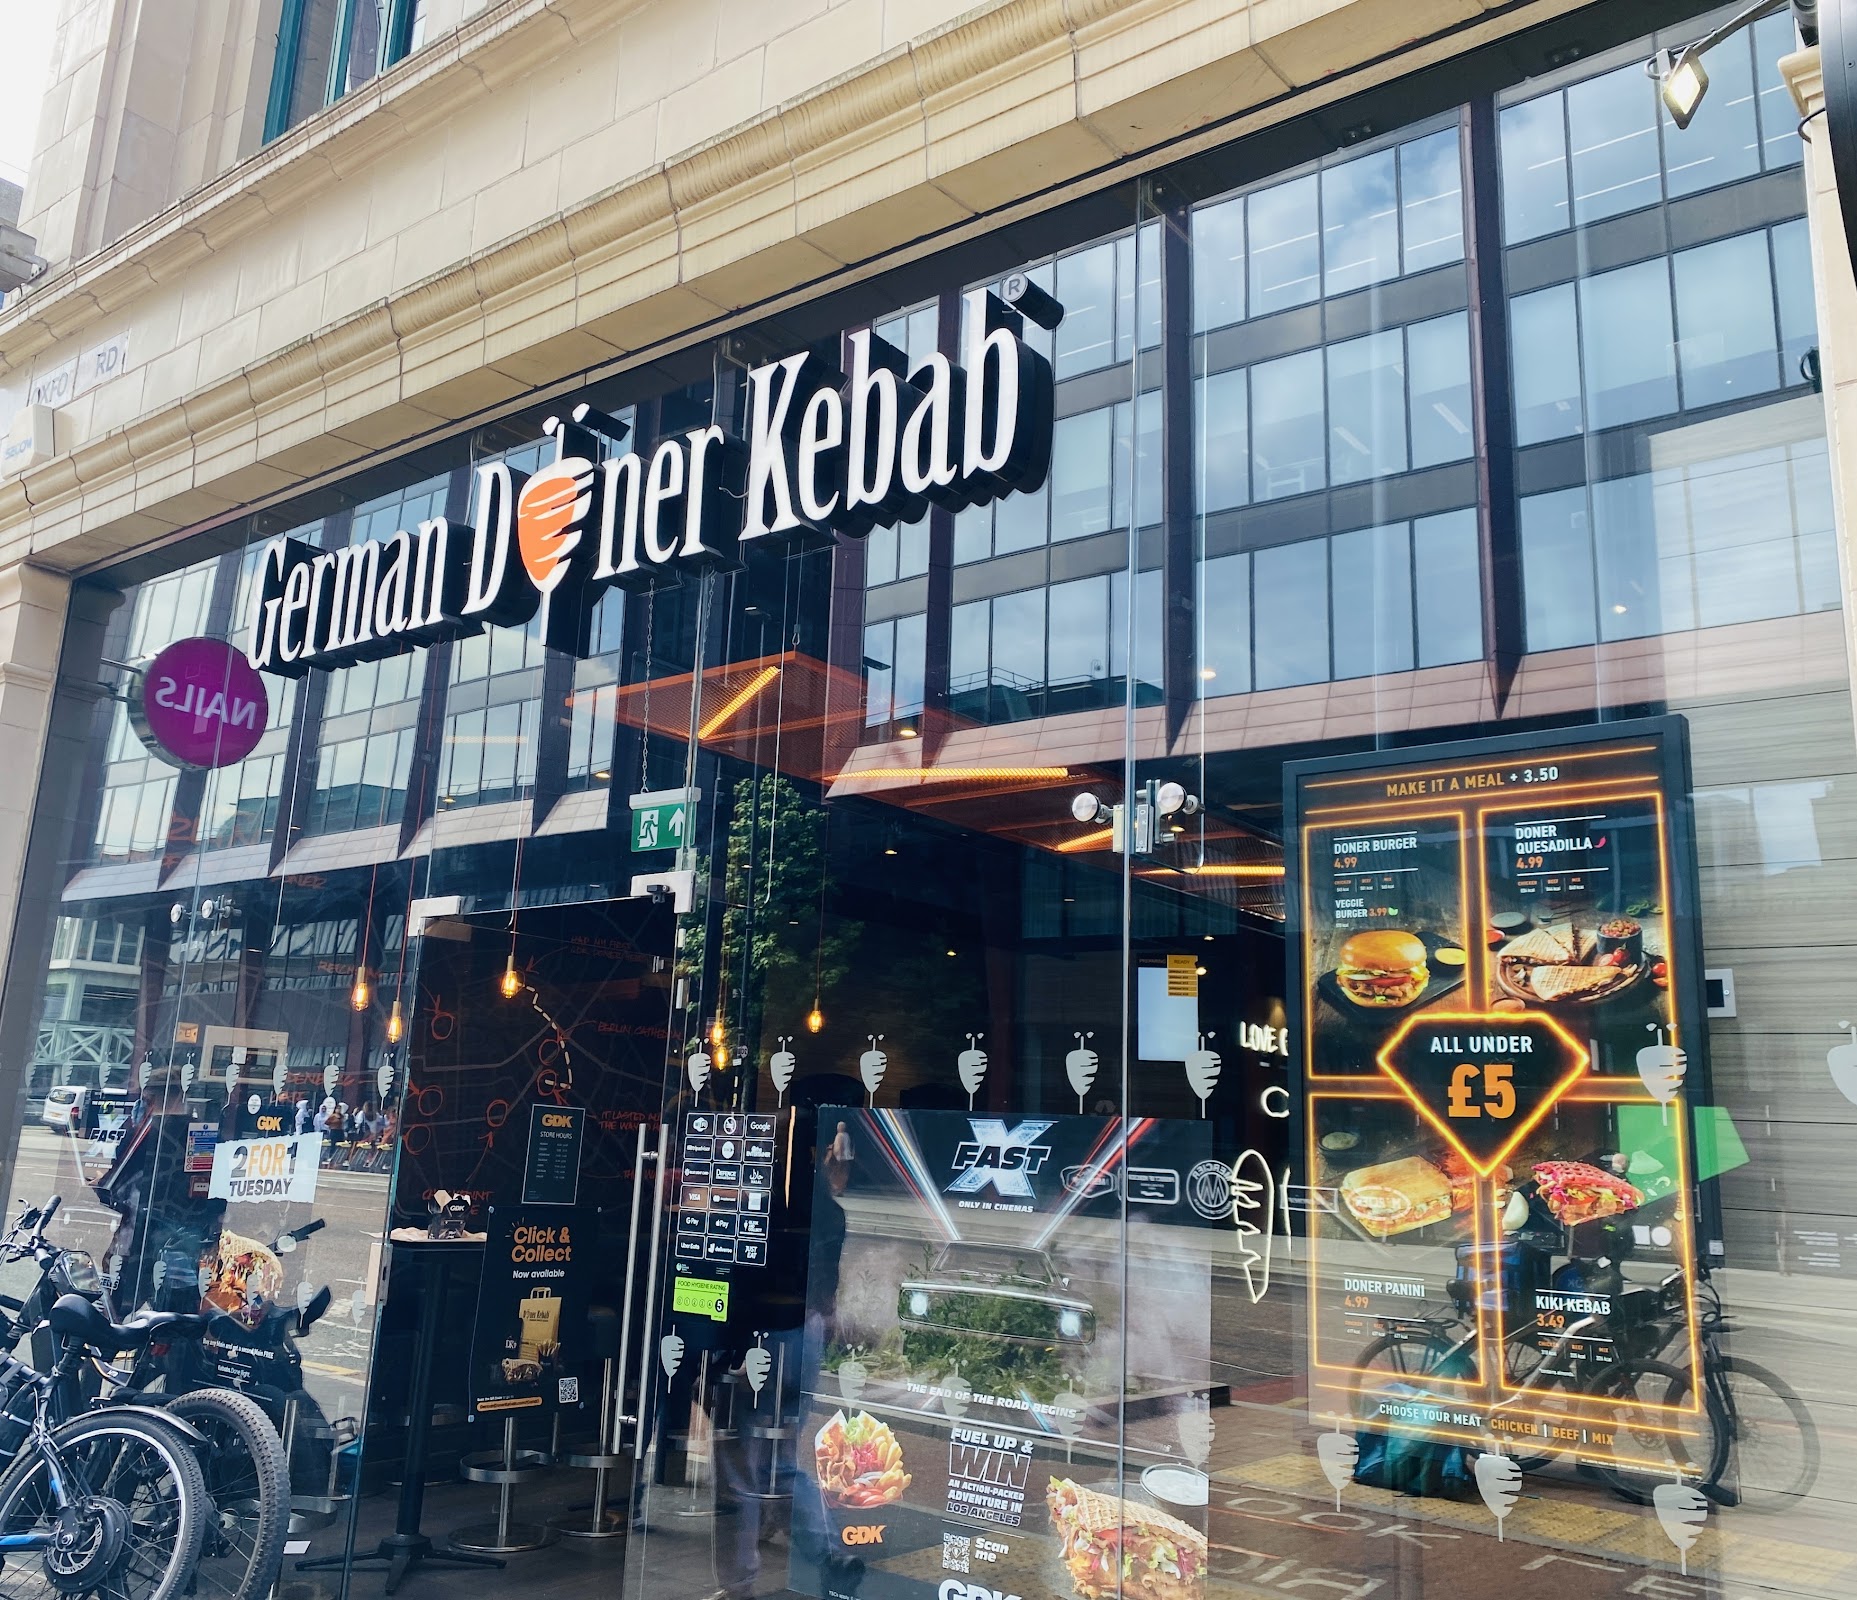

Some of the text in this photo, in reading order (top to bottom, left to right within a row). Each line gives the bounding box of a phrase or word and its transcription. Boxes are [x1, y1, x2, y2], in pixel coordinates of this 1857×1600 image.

[247, 516, 449, 670] German
[738, 287, 1019, 541] Kebab
[1387, 781, 1426, 797] MAKE
[1431, 779, 1446, 793] IT
[1450, 777, 1460, 791] A
[1465, 773, 1505, 789] MEAL
[1524, 766, 1559, 783] 3.50
[1515, 825, 1557, 840] DONER
[1334, 837, 1418, 854] DONER BURGER
[1515, 836, 1594, 855] QUESADILLA
[1334, 857, 1358, 869] 4.99
[1516, 856, 1543, 869] 4.99
[1335, 898, 1365, 909] VEGGIE
[1335, 907, 1387, 919] BURGER 3.99
[1240, 1021, 1279, 1053] LOVE
[1430, 1036, 1534, 1054] ALL UNDER
[1447, 1063, 1517, 1119] £5
[257, 1115, 284, 1132] GDK
[541, 1113, 573, 1128] GDK
[750, 1121, 771, 1132] Google
[89, 1128, 127, 1145] FAST
[540, 1131, 573, 1140] STORE HOURS
[950, 1141, 1053, 1175] FAST
[229, 1178, 294, 1197] TUESDAY
[688, 1192, 700, 1201] VISA
[958, 1200, 981, 1209] ONLY
[994, 1204, 1034, 1213] CINEMAS
[514, 1226, 571, 1244] Click &
[511, 1245, 572, 1263] Collect
[744, 1245, 759, 1253] JUST
[512, 1268, 565, 1279] Now available
[710, 1284, 726, 1292] RATING
[1344, 1278, 1426, 1298] DONER PANINI
[1344, 1295, 1369, 1309] 4.99
[1535, 1295, 1612, 1315] KIKI KEBAB
[1536, 1313, 1565, 1328] 3.49
[906, 1382, 1078, 1419] THE END OF THE ROAD BEGINS
[1379, 1403, 1614, 1446] CHOOSE YOUR MEAT CHICKEN BEEF MIX
[951, 1427, 1035, 1454] FUEL UP &
[949, 1441, 1032, 1490] WIN
[948, 1478, 1025, 1501] AN ACTION-PACKED
[947, 1489, 1023, 1514] ADVENTURE IN
[946, 1501, 1021, 1527] LOS ANGELES
[842, 1524, 887, 1547] GDK
[974, 1537, 1010, 1555] Scan
[974, 1548, 997, 1563] me
